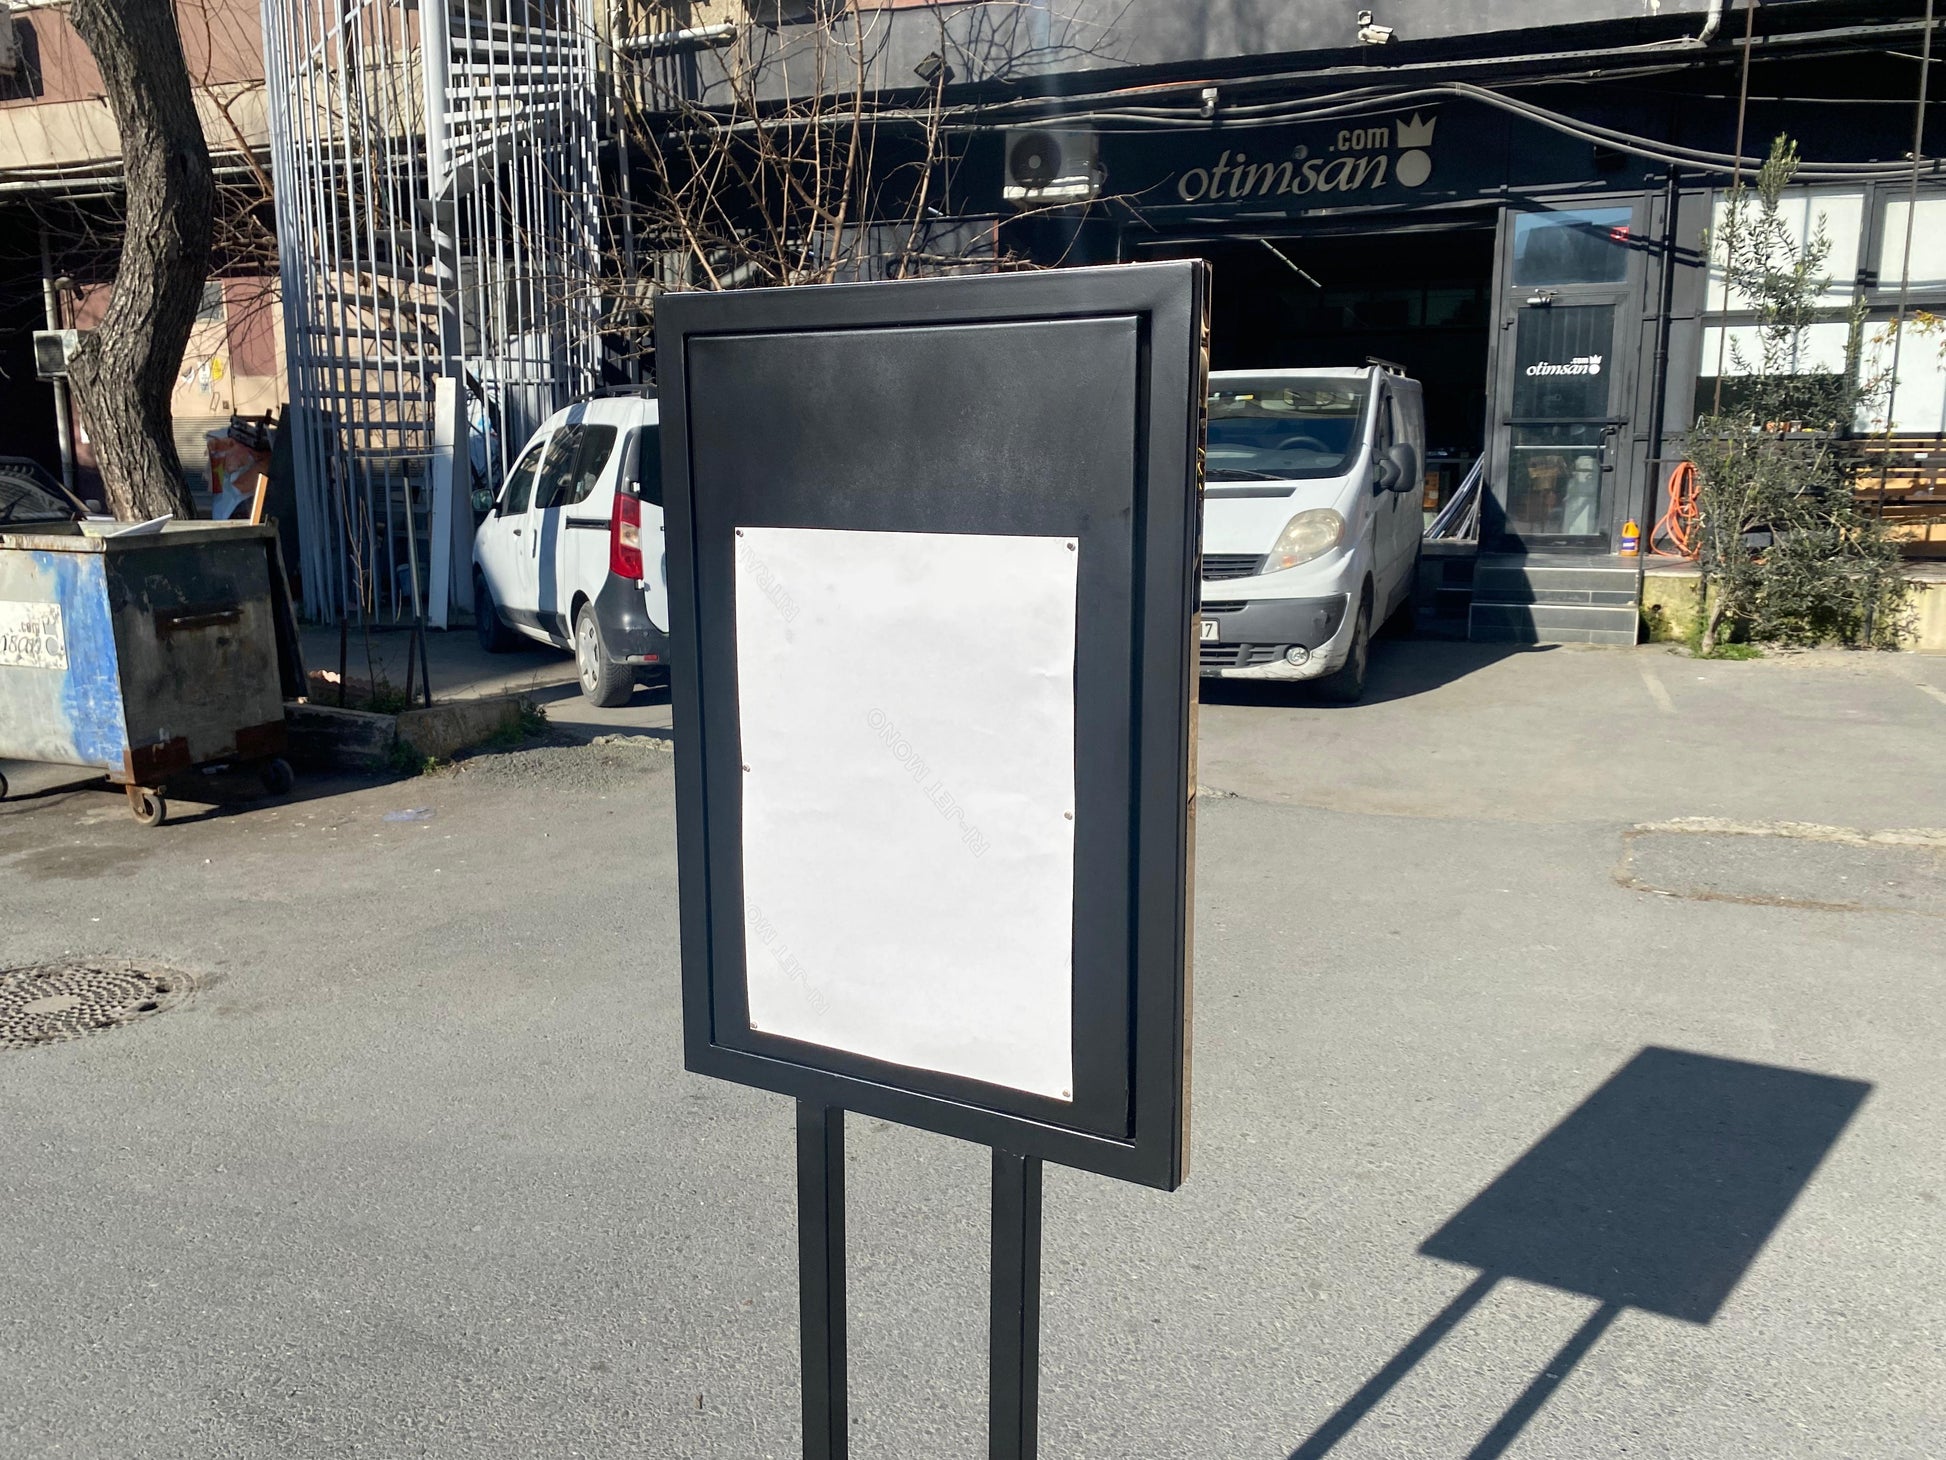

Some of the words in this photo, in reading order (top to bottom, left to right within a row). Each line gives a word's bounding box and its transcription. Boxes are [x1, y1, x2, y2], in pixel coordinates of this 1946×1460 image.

[1329, 127, 1389, 152] .com
[1177, 149, 1388, 201] otimsan
[1526, 361, 1588, 375] otimsan
[867, 707, 930, 784] MONO
[923, 781, 991, 858] RI-JET
